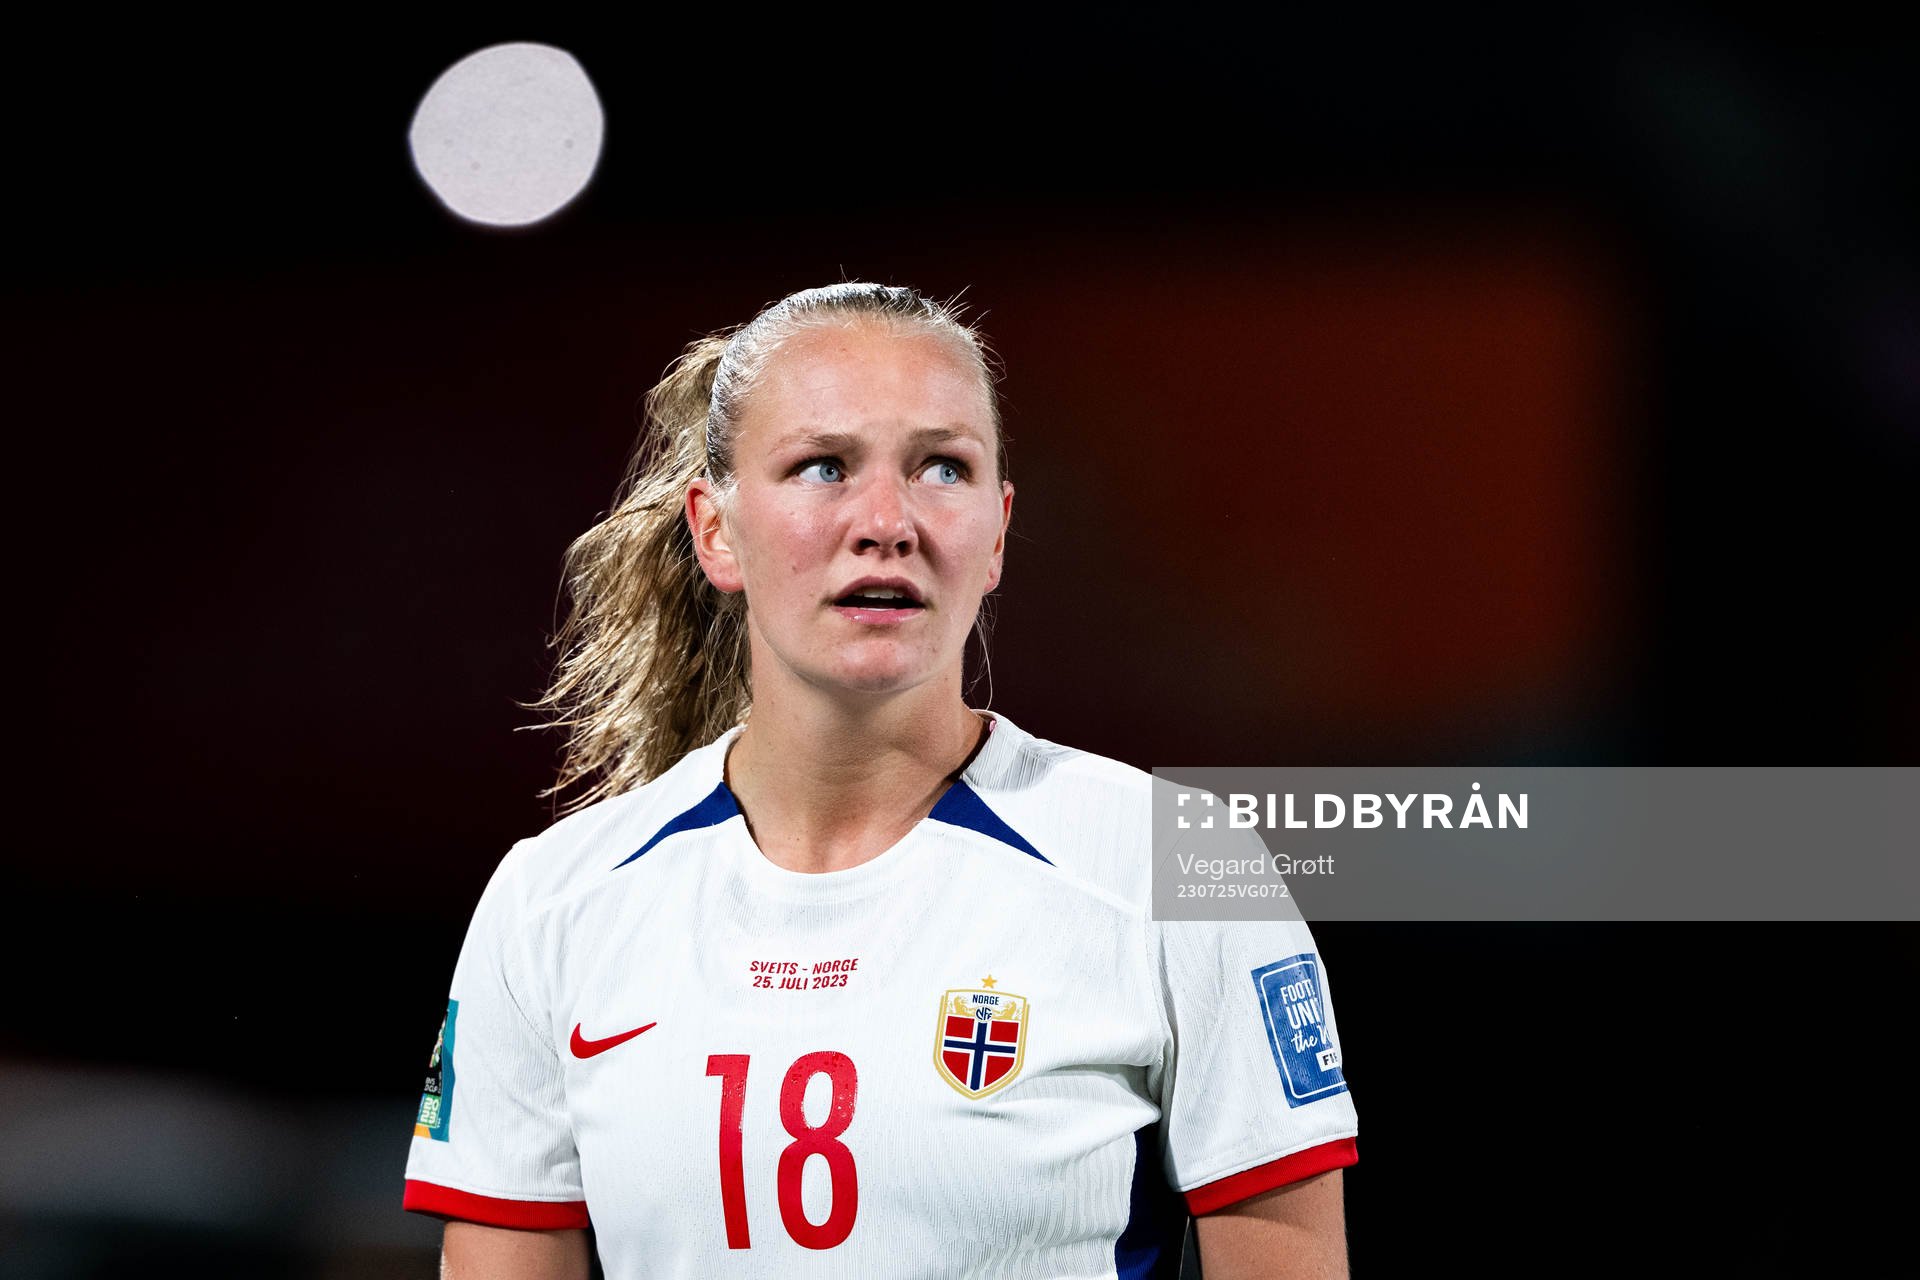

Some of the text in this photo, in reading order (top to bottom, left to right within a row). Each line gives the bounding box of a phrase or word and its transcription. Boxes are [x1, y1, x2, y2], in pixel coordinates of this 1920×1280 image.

[749, 960, 799, 976] SVEITS
[812, 958, 859, 975] NORGE
[752, 974, 848, 990] 25. JULI 2023
[972, 993, 1000, 1006] NORGE
[1280, 979, 1315, 1004] FOOT
[1286, 997, 1320, 1030] UNI
[1291, 1029, 1317, 1054] the
[424, 1097, 440, 1111] 20
[420, 1110, 437, 1125] 23
[705, 1050, 858, 1250] 18
